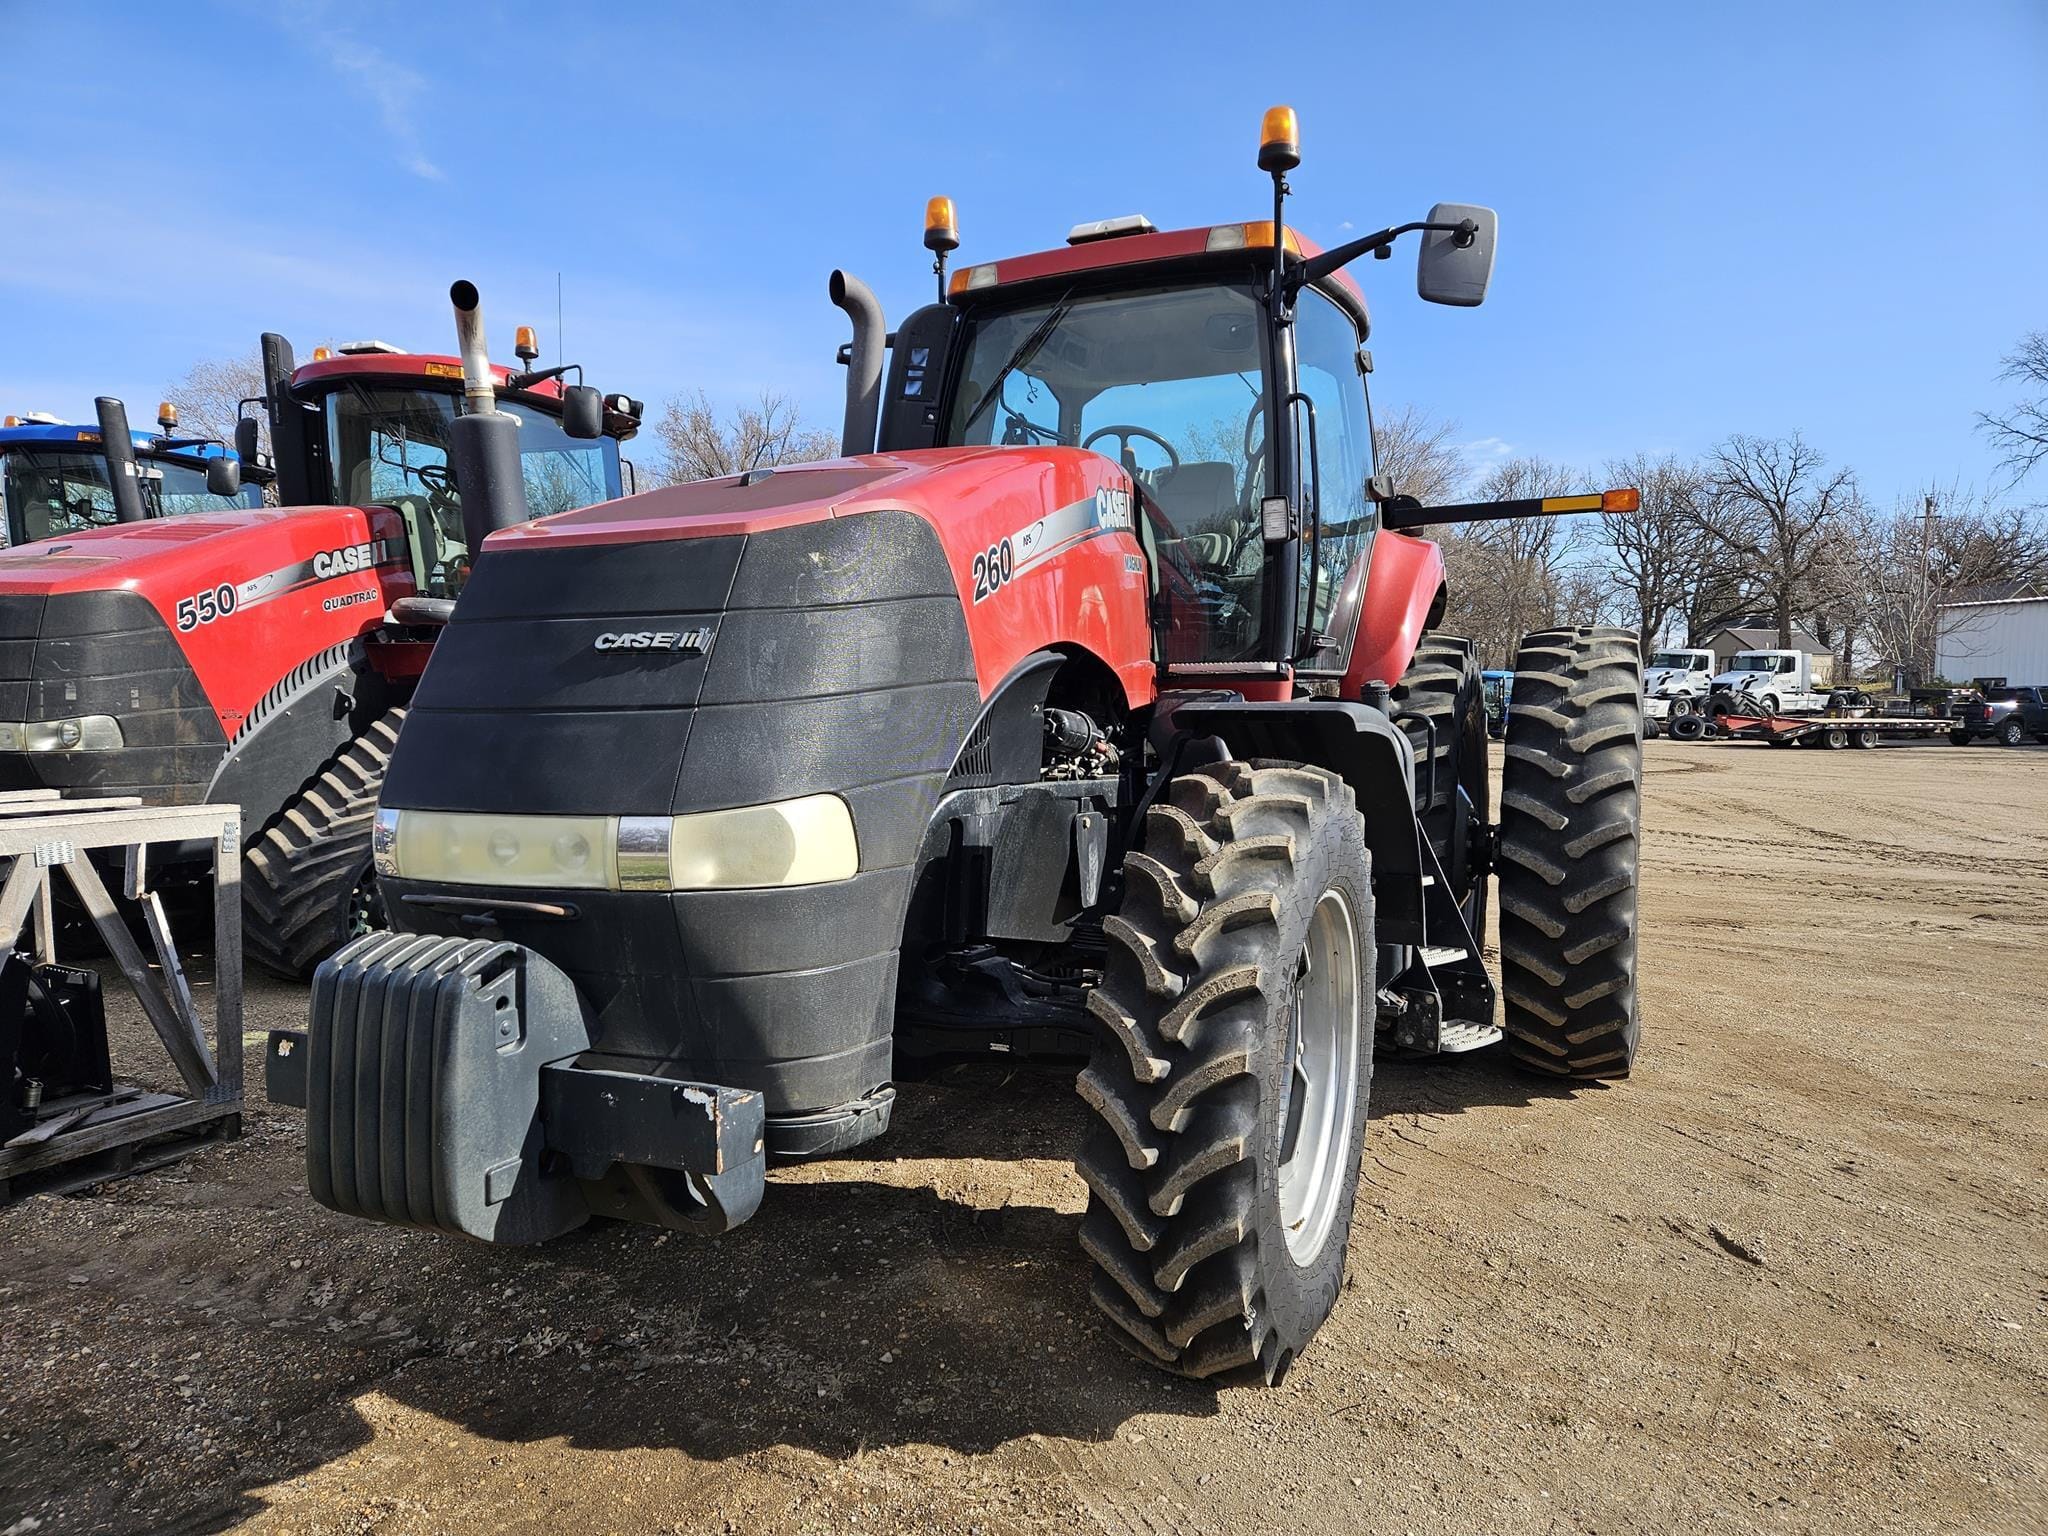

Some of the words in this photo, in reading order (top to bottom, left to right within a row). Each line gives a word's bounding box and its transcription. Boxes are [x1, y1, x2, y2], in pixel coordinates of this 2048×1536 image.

[973, 537, 1013, 604] 260
[177, 584, 236, 632] 550
[322, 589, 378, 611] QUADTRAC
